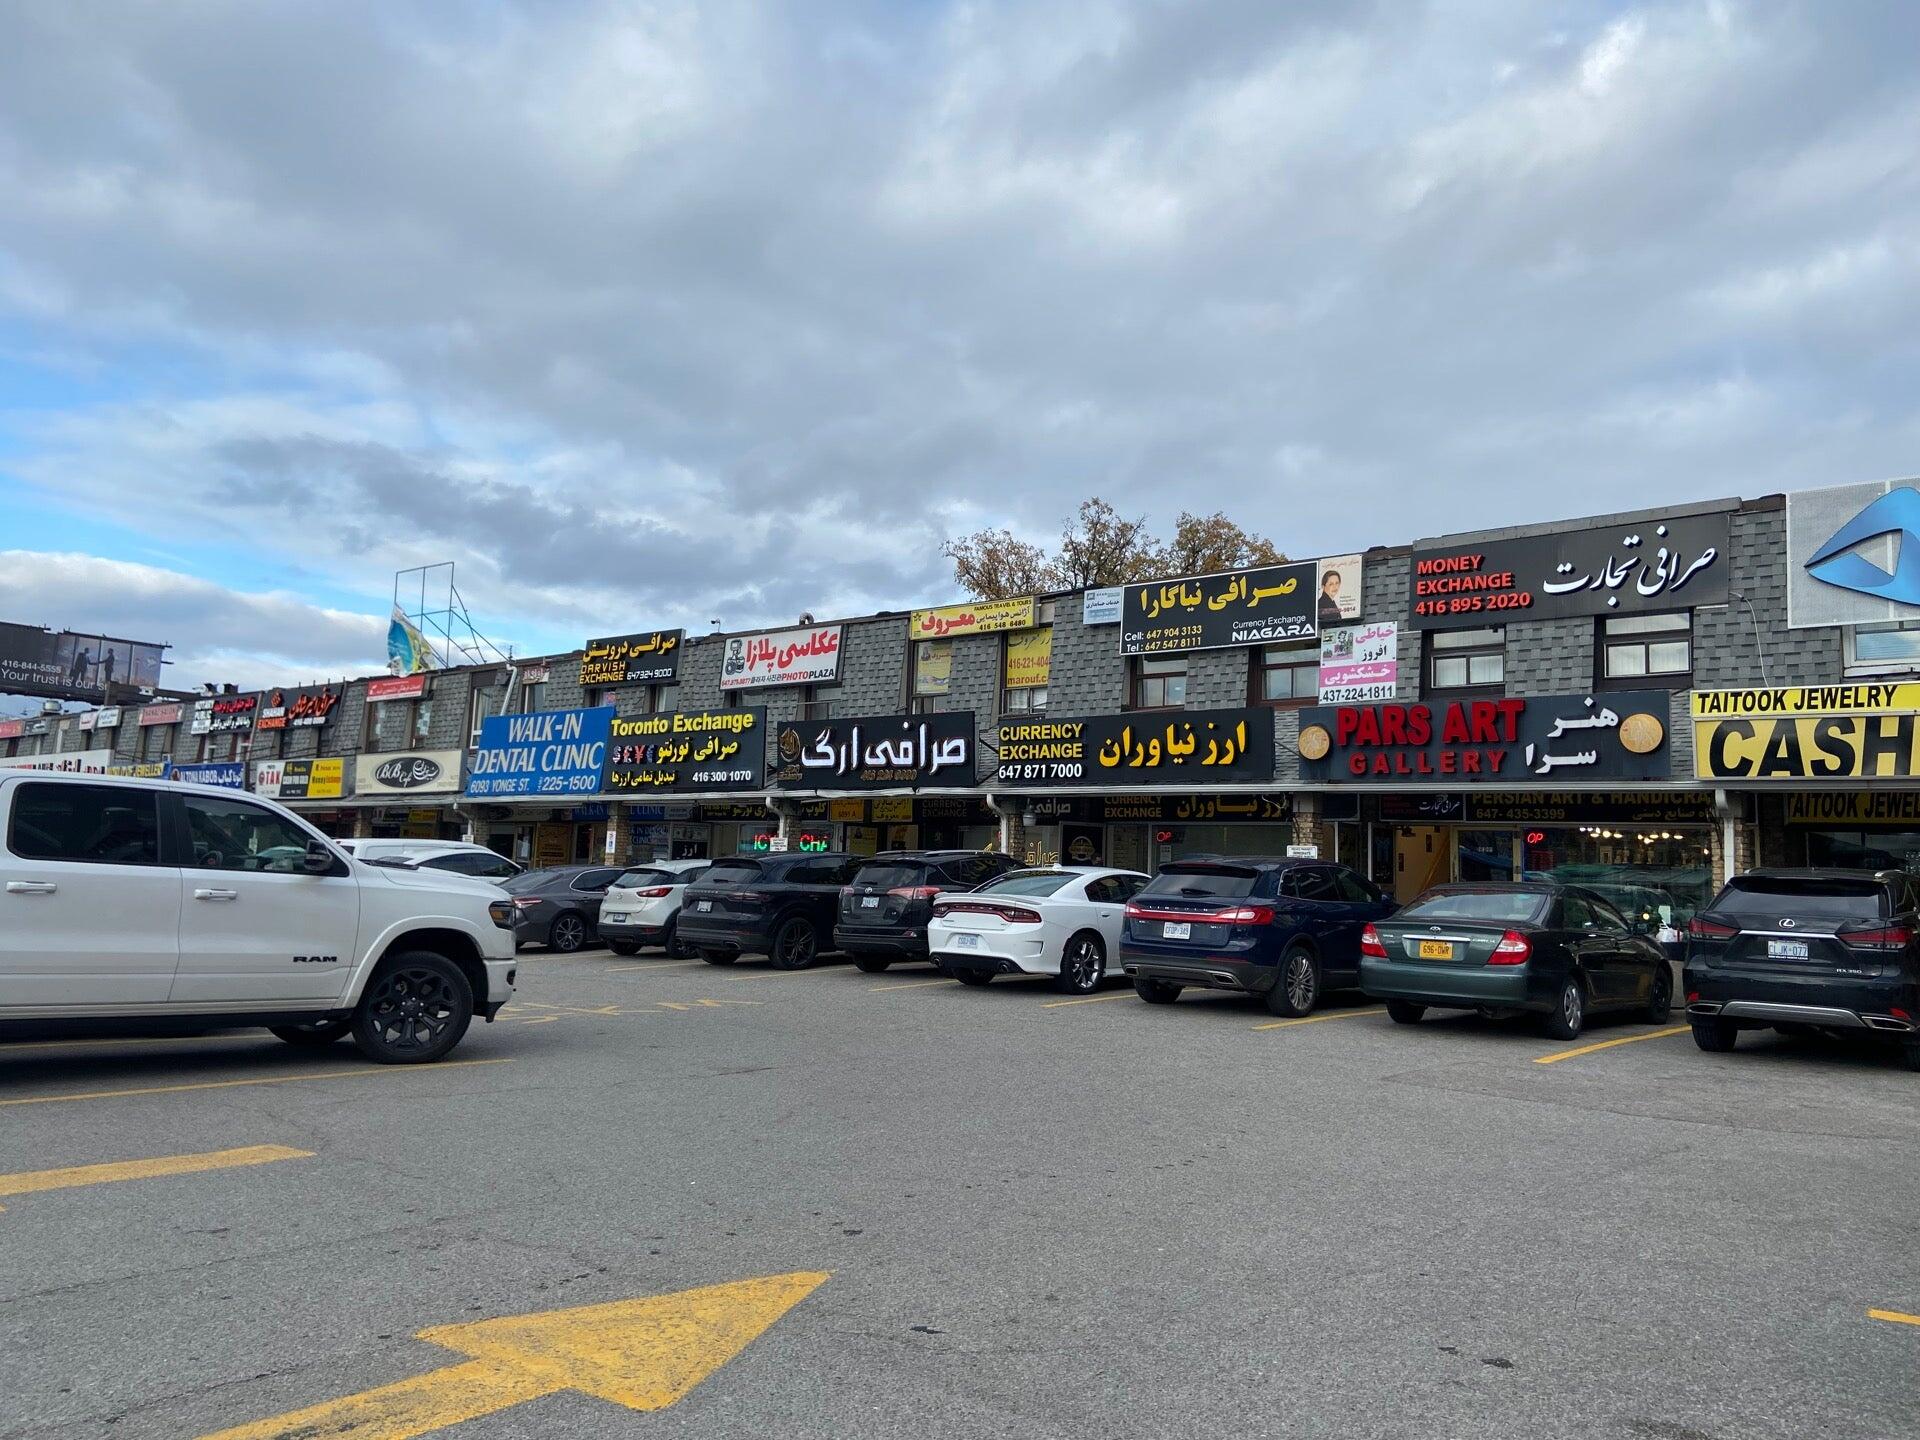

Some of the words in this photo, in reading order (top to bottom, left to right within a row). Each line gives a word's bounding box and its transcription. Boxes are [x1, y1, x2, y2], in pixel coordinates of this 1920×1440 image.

[1416, 554, 1482, 575] MONEY
[1543, 534, 1638, 606] تجارت
[1636, 525, 1716, 596] صرافی
[1208, 575, 1298, 611] صرافی
[1416, 572, 1513, 595] EXCHANGE
[1140, 581, 1203, 619] نیاگارا
[1415, 600, 1447, 616] 416
[1450, 597, 1482, 613] 895
[1486, 592, 1532, 611] 2020
[920, 611, 976, 636] معروف
[979, 623, 991, 631] 416
[1125, 631, 1144, 642] Cell:
[1146, 629, 1162, 640] 647
[1164, 627, 1180, 638] 904
[1181, 624, 1202, 636] 3133
[1232, 618, 1266, 630] Currency
[1268, 614, 1307, 628] Exchange
[1232, 623, 1315, 642] NIAGARA
[629, 632, 676, 658] صرافی
[1145, 641, 1161, 651] 647
[1162, 639, 1179, 649] 547
[1180, 636, 1201, 648] 8111
[1355, 625, 1394, 645] خیاطی
[582, 640, 628, 663] درویش
[746, 637, 777, 673] پلازا
[778, 630, 838, 669] عکاسی
[2, 668, 29, 682] Your
[33, 672, 59, 686] trust
[62, 677, 74, 688] is
[75, 680, 96, 690] our
[579, 671, 625, 685] EXCHANGE
[581, 661, 626, 675] DARVISH
[1323, 685, 1393, 702] 437-224-1811
[1698, 689, 1789, 713] TAITOOK
[1793, 685, 1899, 710] JEWELRY
[257, 717, 287, 730] EXCHANGE
[508, 712, 584, 743] WALK-IN
[611, 717, 669, 737] Toronto
[673, 712, 754, 734] Exchange
[1336, 704, 1432, 747] PARS
[1441, 699, 1526, 743] ART
[1546, 696, 1620, 738] هنر
[1000, 722, 1084, 742] CURRENCY
[1201, 720, 1247, 766] ارز
[693, 736, 739, 761] صرافی
[801, 725, 858, 776] ارگ
[864, 721, 967, 776] صرافی
[999, 742, 1084, 761] EXCHANGE
[1099, 722, 1196, 768] نیاوران
[1709, 715, 1915, 777] CASH
[473, 746, 537, 775] DENTAL
[541, 741, 605, 772] CLINIC
[1350, 751, 1508, 775] GALLERY
[1525, 742, 1597, 774] سرا
[200, 769, 218, 784] KABOB
[692, 771, 709, 783] 416
[710, 771, 727, 782] 300
[729, 770, 752, 782] 1070
[999, 764, 1021, 779] 647
[1023, 764, 1047, 779] 871
[1050, 763, 1083, 778] 7000
[470, 780, 490, 793] 6093
[492, 778, 516, 793] YONGE
[518, 778, 530, 792] ST.
[541, 775, 597, 791] 225-1500
[1473, 792, 1544, 805] PERSIAN
[1552, 792, 1583, 805] ART
[1788, 793, 1859, 818] TAITOOK
[1104, 807, 1163, 818] EXCHANGE
